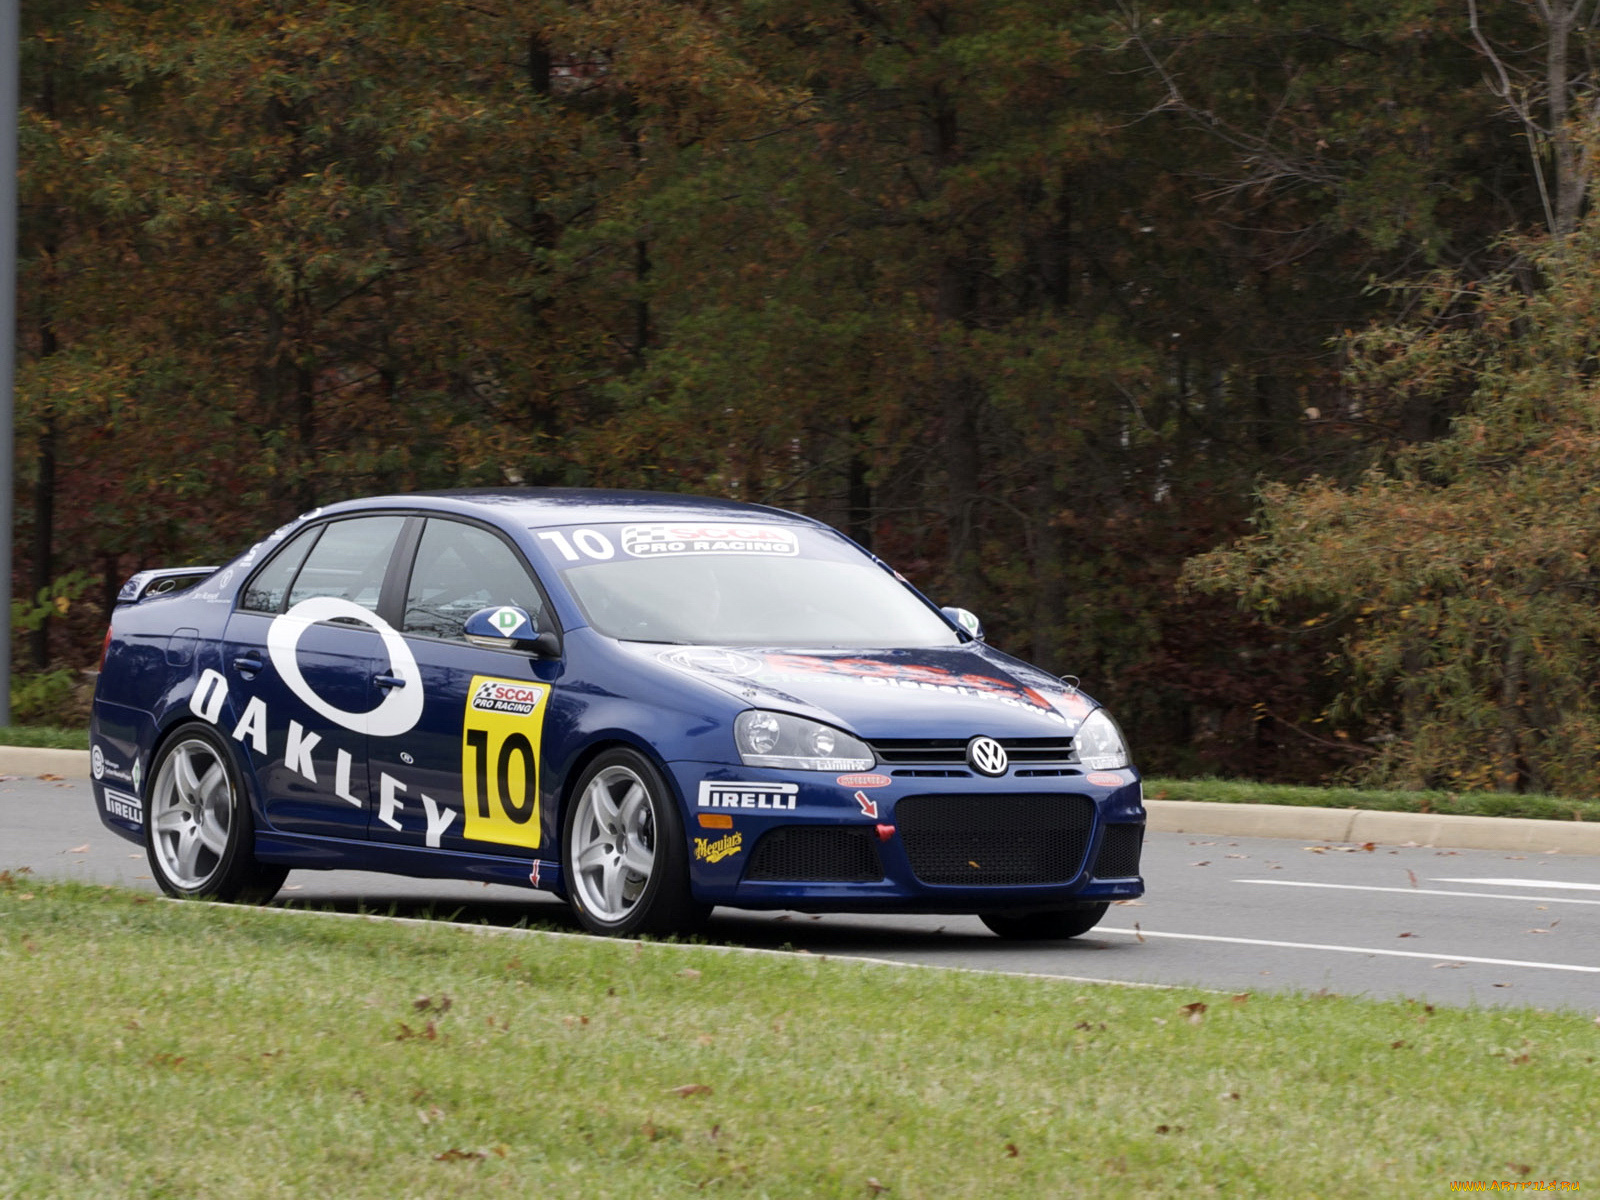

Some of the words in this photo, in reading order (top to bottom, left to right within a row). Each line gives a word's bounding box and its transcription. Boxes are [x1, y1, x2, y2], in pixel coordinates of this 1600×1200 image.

[537, 528, 615, 560] 10
[669, 527, 786, 540] SCCA
[635, 541, 687, 553] PRO
[693, 541, 790, 552] RACING
[499, 611, 517, 628] D
[474, 698, 493, 709] PRO
[494, 701, 532, 713] RACING
[494, 687, 535, 703] SCCA
[189, 668, 457, 848] OAKLEY
[466, 728, 537, 825] 10
[104, 787, 143, 825] PIRELLI
[698, 780, 799, 810] PIRELLI
